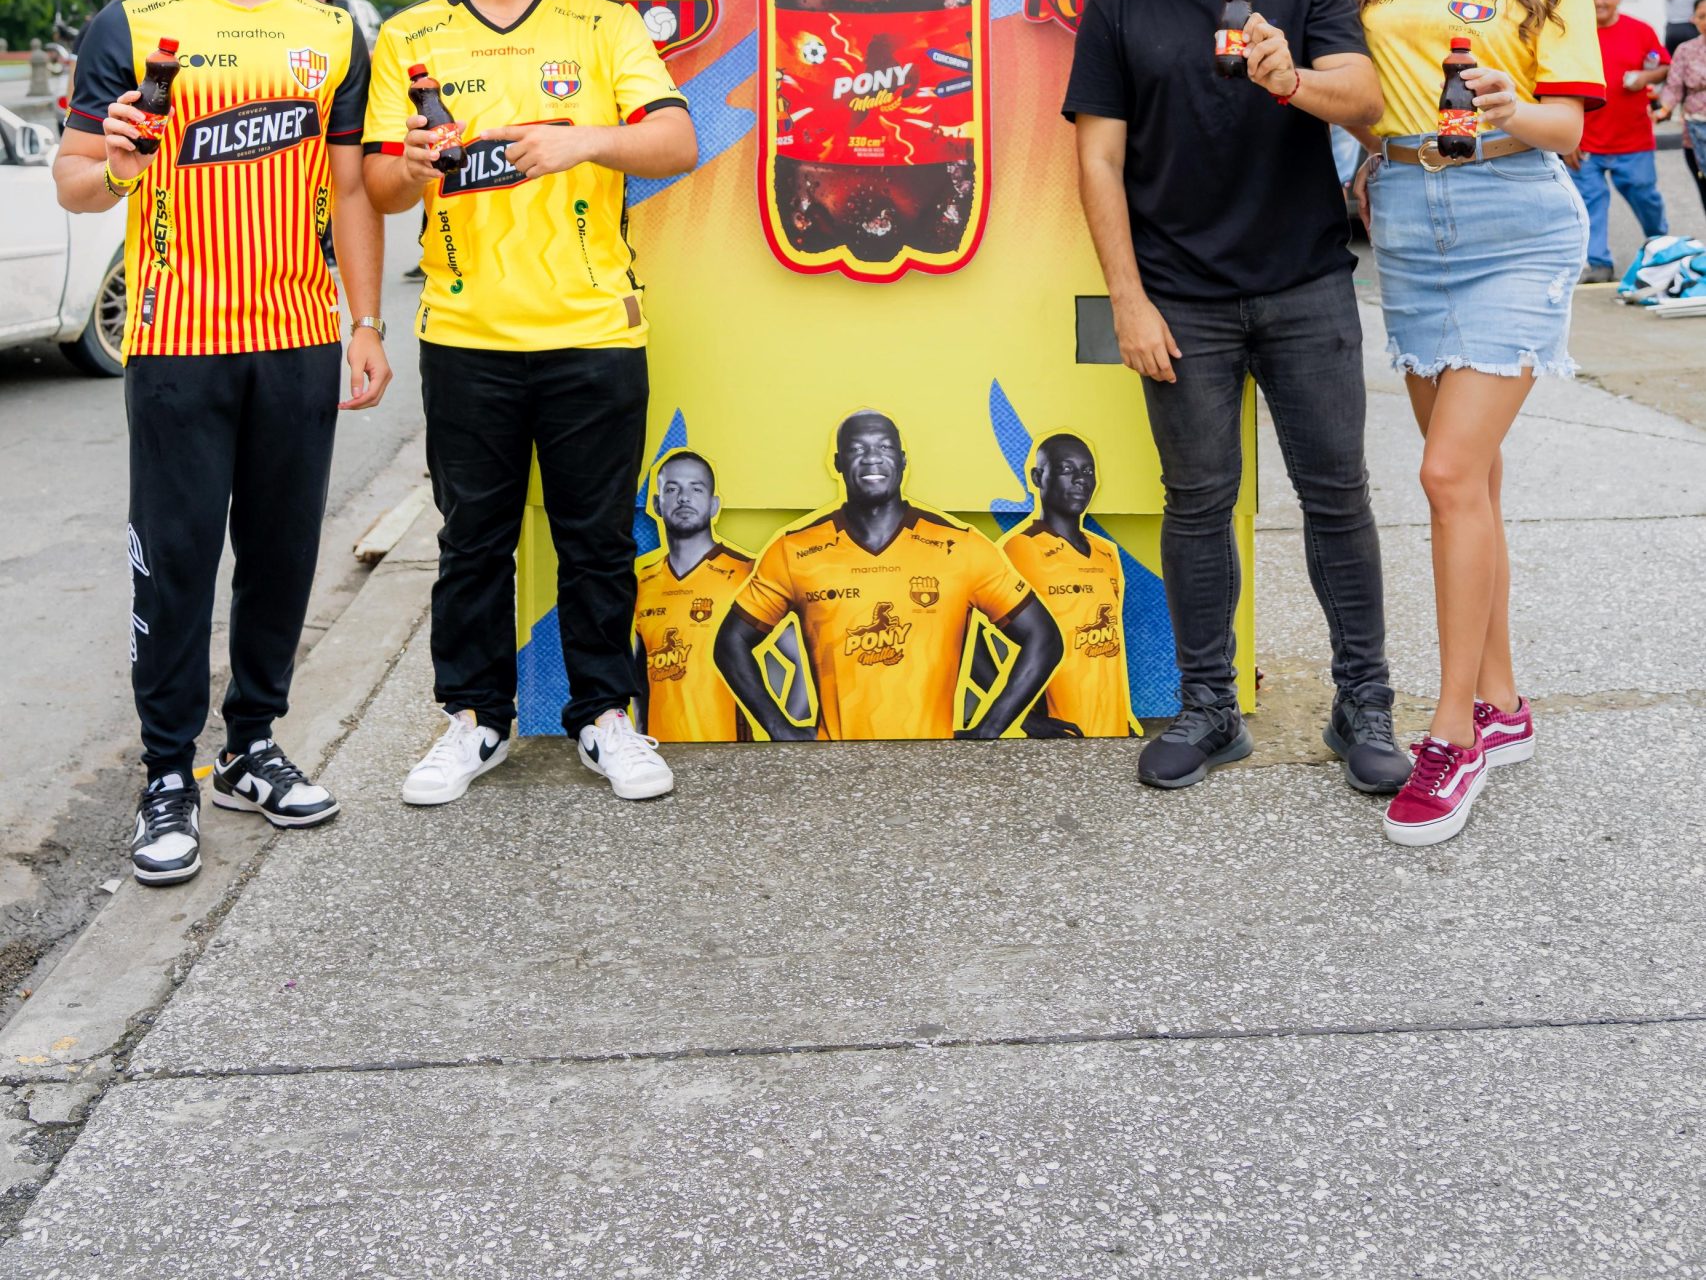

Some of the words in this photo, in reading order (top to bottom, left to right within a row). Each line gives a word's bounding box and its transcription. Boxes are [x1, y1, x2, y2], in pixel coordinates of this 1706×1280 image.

[217, 28, 285, 39] marathon
[472, 46, 535, 58] marathon
[179, 54, 239, 68] COVER
[442, 79, 486, 96] OVER
[833, 62, 914, 100] PONY
[238, 106, 268, 116] CERVEZA
[776, 135, 794, 146] 025
[316, 186, 328, 238] ET593
[438, 210, 451, 233] bet
[851, 565, 901, 574] marathon
[805, 588, 861, 603] DISCOVER
[844, 622, 913, 657] PONY
